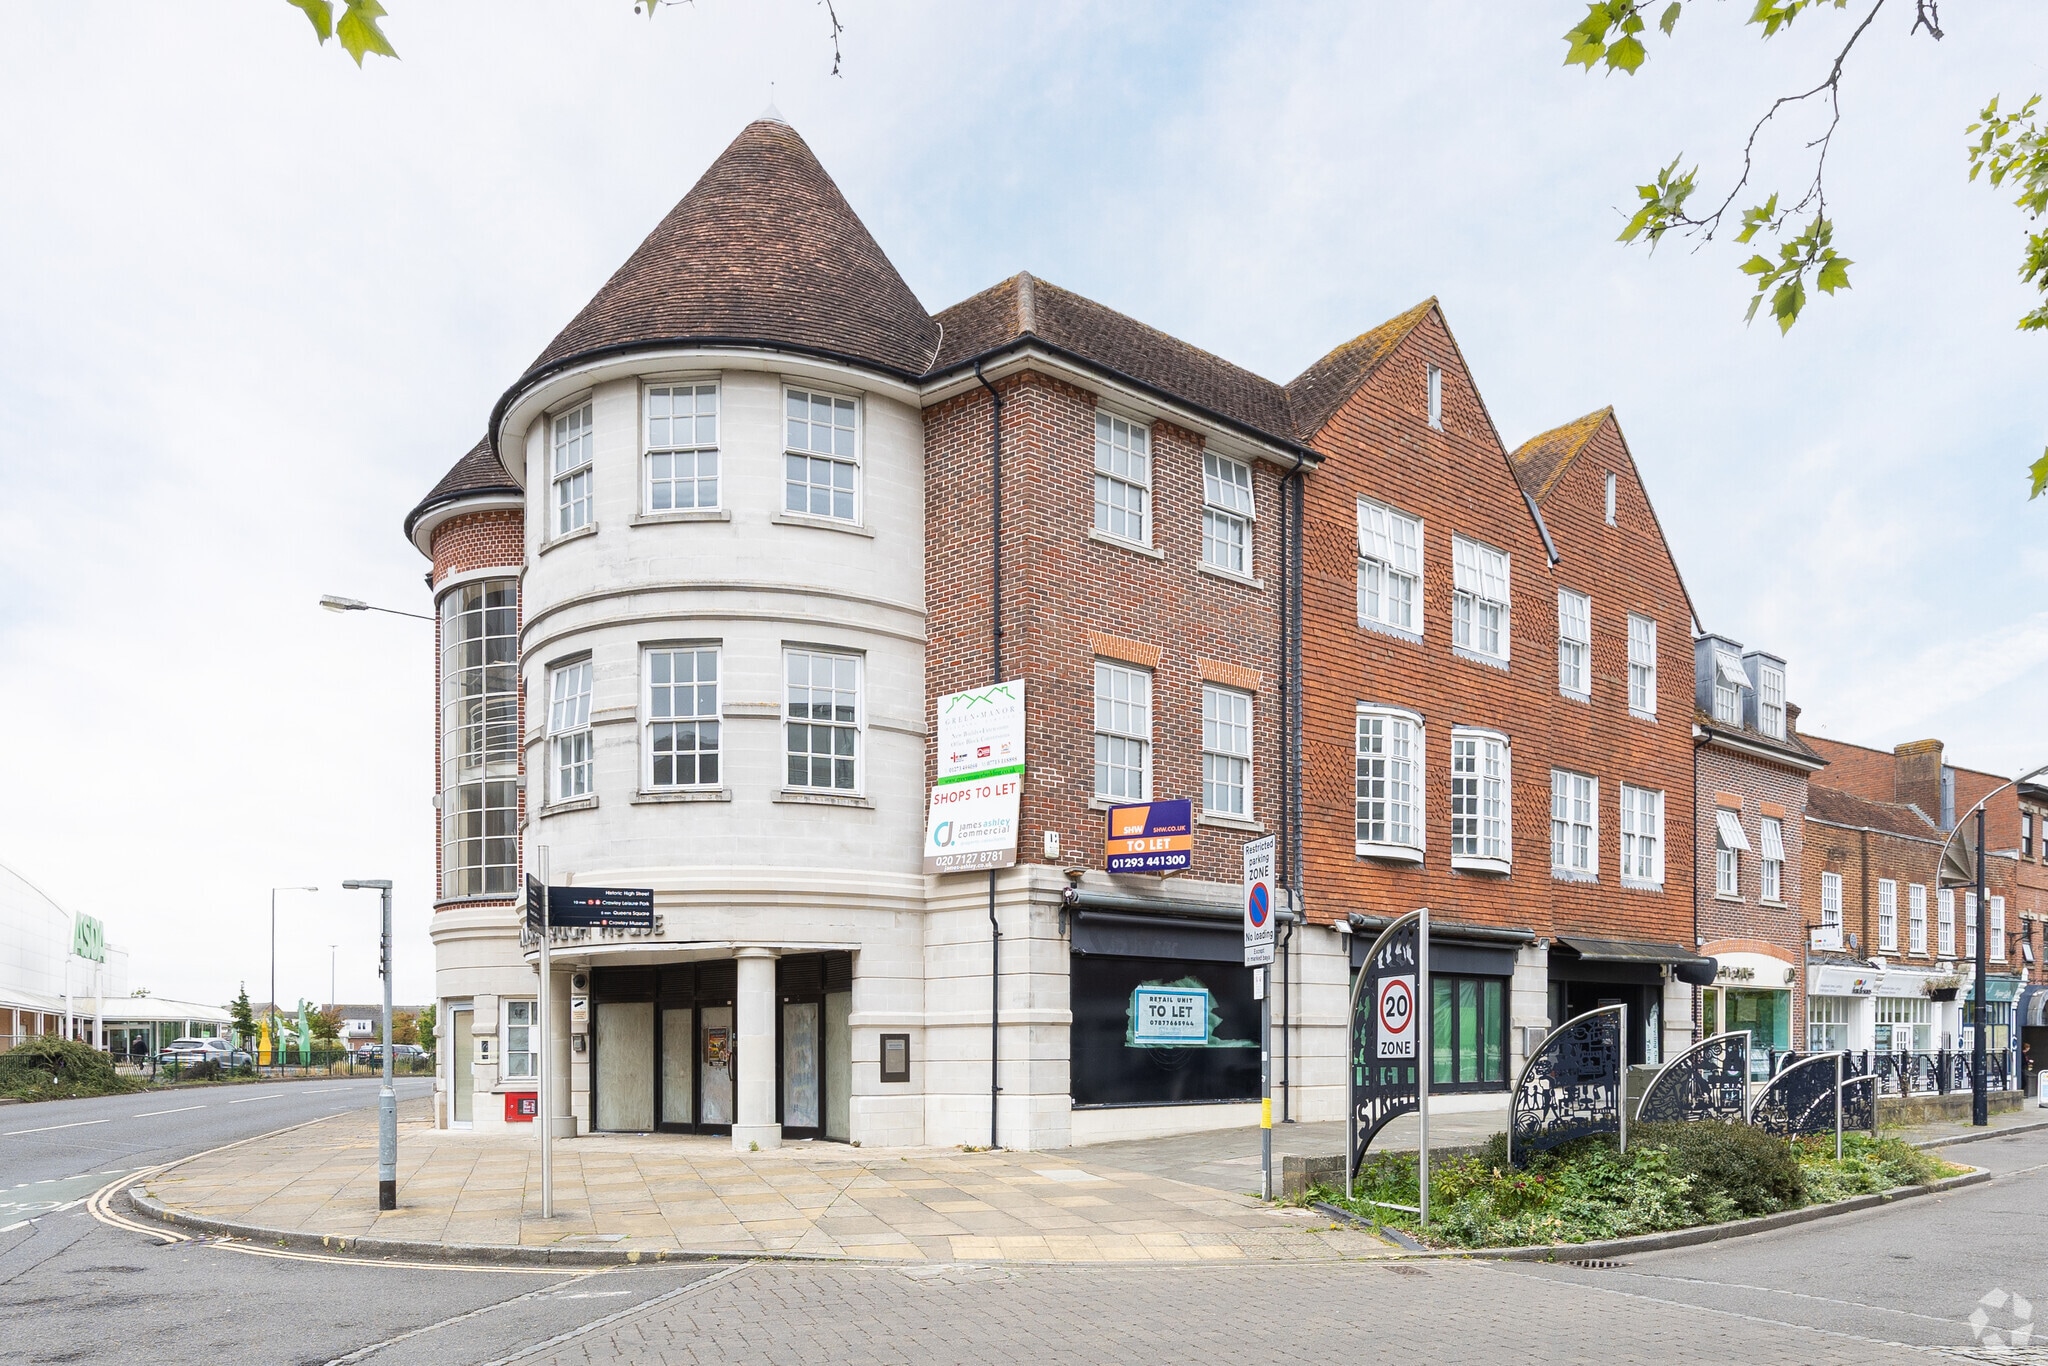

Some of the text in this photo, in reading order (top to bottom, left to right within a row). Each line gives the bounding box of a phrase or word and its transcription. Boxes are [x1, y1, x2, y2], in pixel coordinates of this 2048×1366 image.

[933, 782, 1016, 805] SHOPS TO LET
[958, 825, 1010, 839] commercial
[959, 818, 1011, 832] james ashley
[1123, 825, 1186, 834] SHW SHW.CO.UK
[1127, 838, 1171, 852] TO LET
[1246, 838, 1274, 856] Restricted
[935, 850, 1003, 867] 020 7127 8781
[1112, 854, 1186, 869] 01293 441300
[1249, 853, 1269, 867] parking
[1249, 865, 1269, 881] ZONE
[73, 910, 106, 964] ASDA
[1245, 929, 1273, 942] No loading
[1148, 1005, 1193, 1018] TO LET
[1385, 995, 1407, 1017] 20
[1381, 1041, 1411, 1055] ZONE
